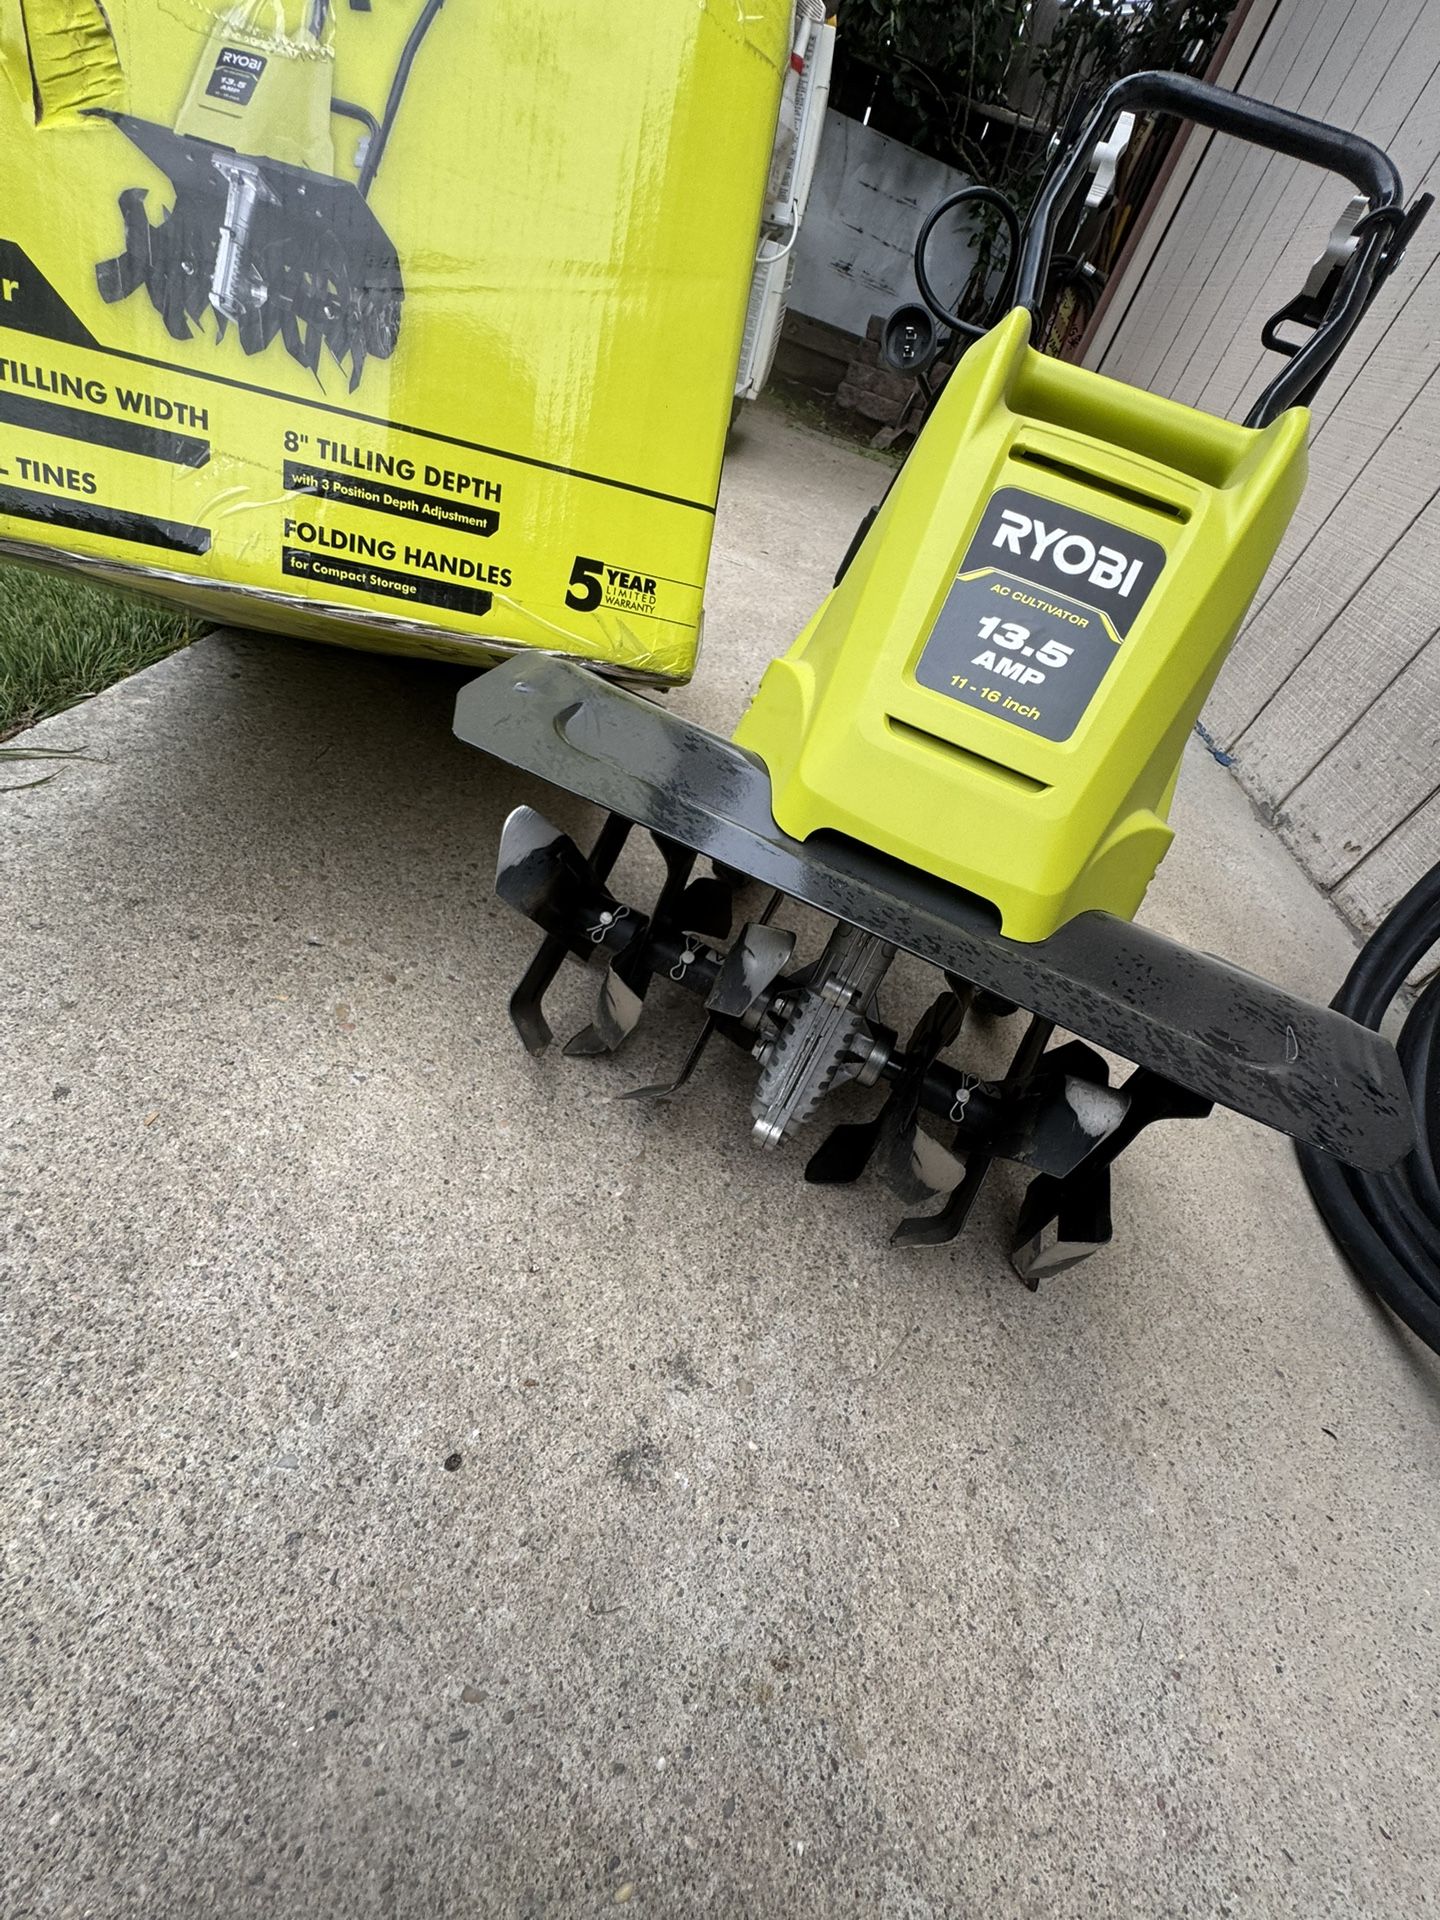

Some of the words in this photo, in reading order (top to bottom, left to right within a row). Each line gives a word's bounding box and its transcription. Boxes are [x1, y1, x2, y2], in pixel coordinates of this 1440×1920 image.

[222, 51, 262, 71] RYOBI
[0, 357, 108, 405] TILLING
[115, 386, 209, 430] WIDTH
[15, 457, 97, 494] TINES
[283, 430, 308, 453] 8"
[316, 437, 415, 481] TILLING
[423, 464, 502, 503] DEPTH
[291, 473, 318, 488] with
[321, 479, 329, 490] 3
[332, 482, 380, 503] Position
[383, 493, 419, 513] Depth
[421, 503, 488, 529] Adjustment
[284, 517, 396, 561] FOLDING
[404, 546, 513, 588] HANDLES
[290, 556, 308, 570] for
[312, 561, 366, 583] Compact
[369, 573, 417, 595] Storage
[991, 509, 1144, 598] RYOBI
[564, 555, 604, 613] 5
[606, 568, 657, 596] YEAR
[605, 595, 656, 614] WARRANTY
[606, 585, 657, 605] LIMITED
[990, 584, 1009, 597] AC
[1011, 590, 1089, 629] CULTIVATOR
[977, 615, 1075, 669] 13.5
[970, 650, 1046, 686] AMP
[950, 674, 968, 687] 11
[979, 686, 1000, 704] 16
[1002, 696, 1041, 721] inch
